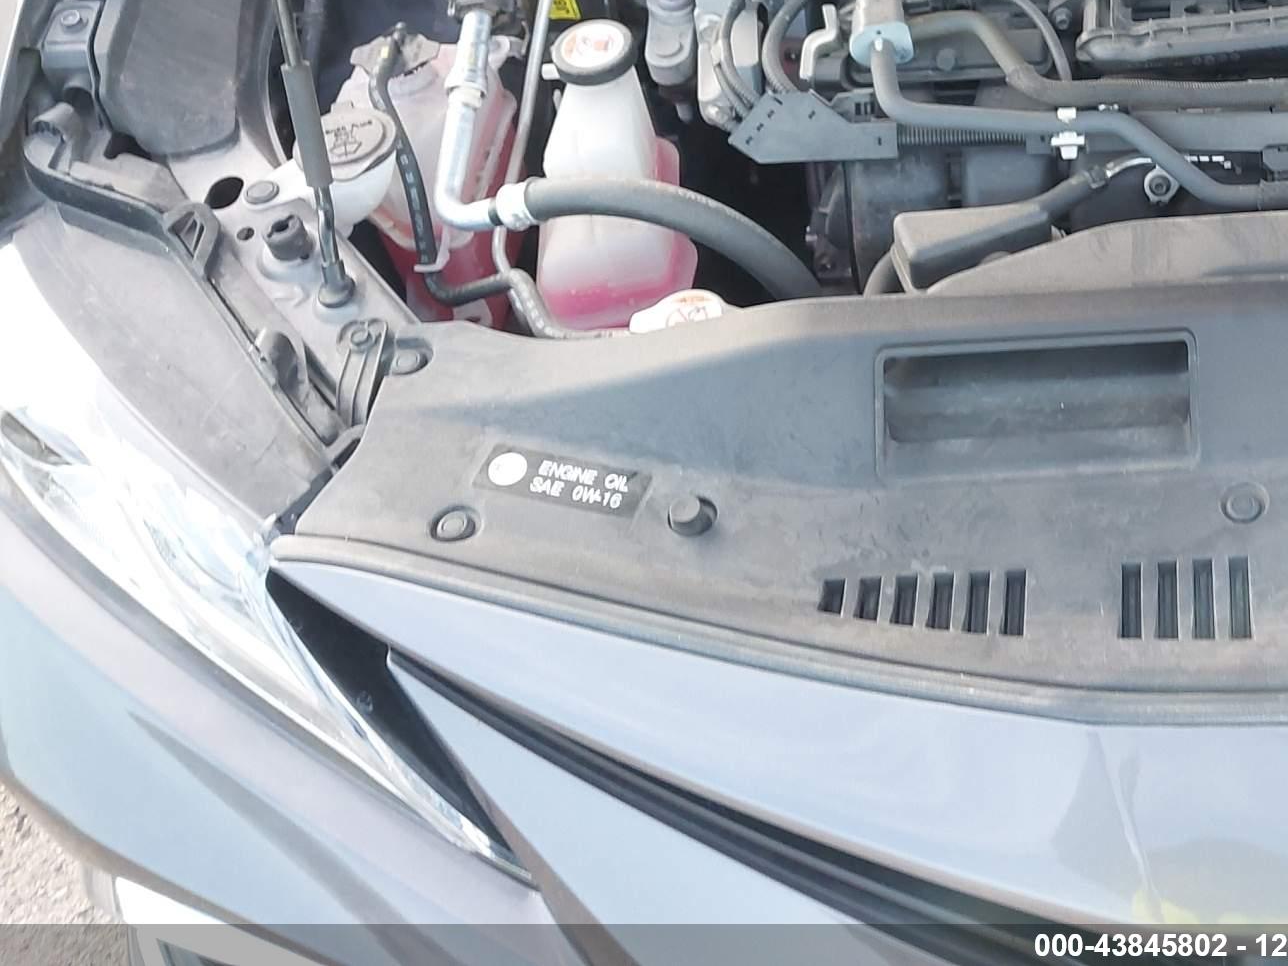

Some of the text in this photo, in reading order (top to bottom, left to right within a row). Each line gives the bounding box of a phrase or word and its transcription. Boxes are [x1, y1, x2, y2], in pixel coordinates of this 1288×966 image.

[538, 460, 629, 492] ENGINE OIL
[530, 476, 623, 509] SAE 0W-16
